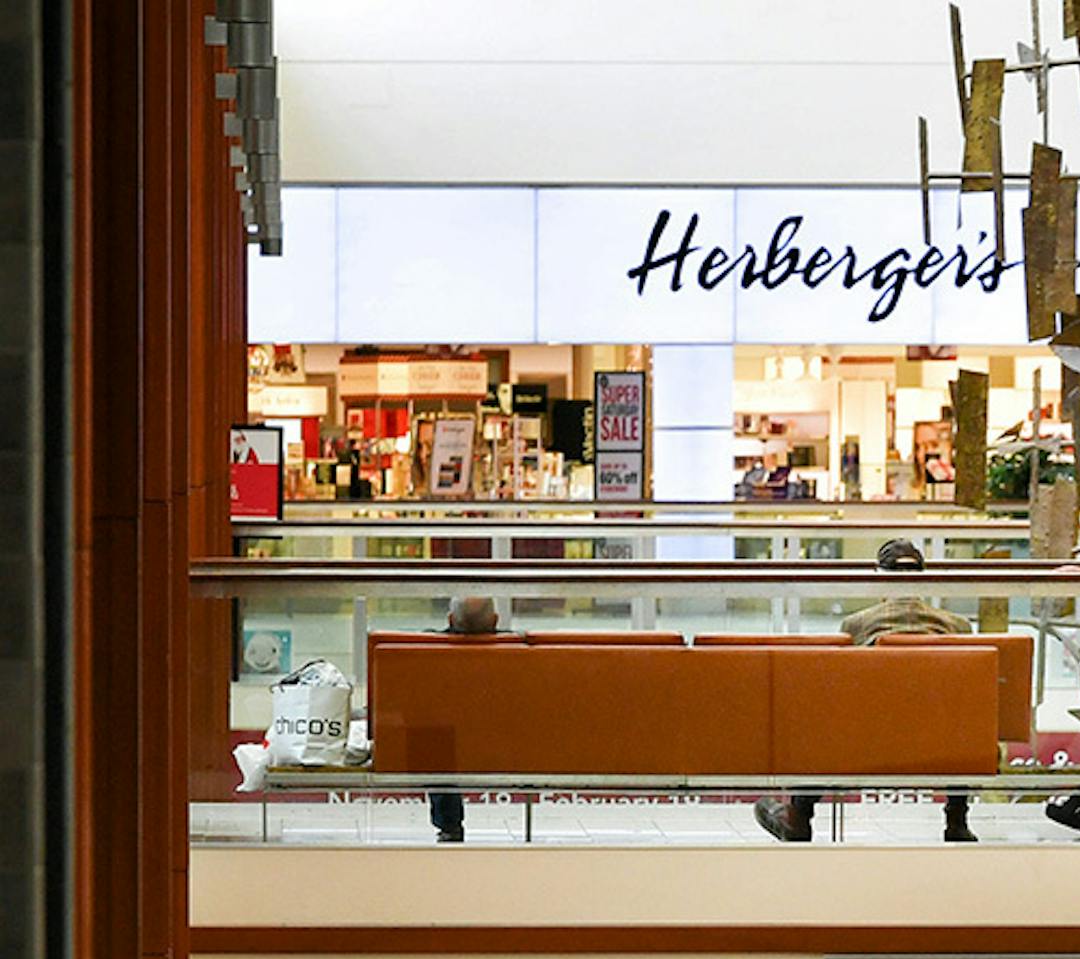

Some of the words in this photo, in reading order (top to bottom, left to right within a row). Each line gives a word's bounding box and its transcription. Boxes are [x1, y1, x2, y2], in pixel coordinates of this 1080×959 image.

[627, 209, 1004, 322] Herberger's
[601, 386, 639, 402] SUPER
[600, 416, 639, 440] SALE
